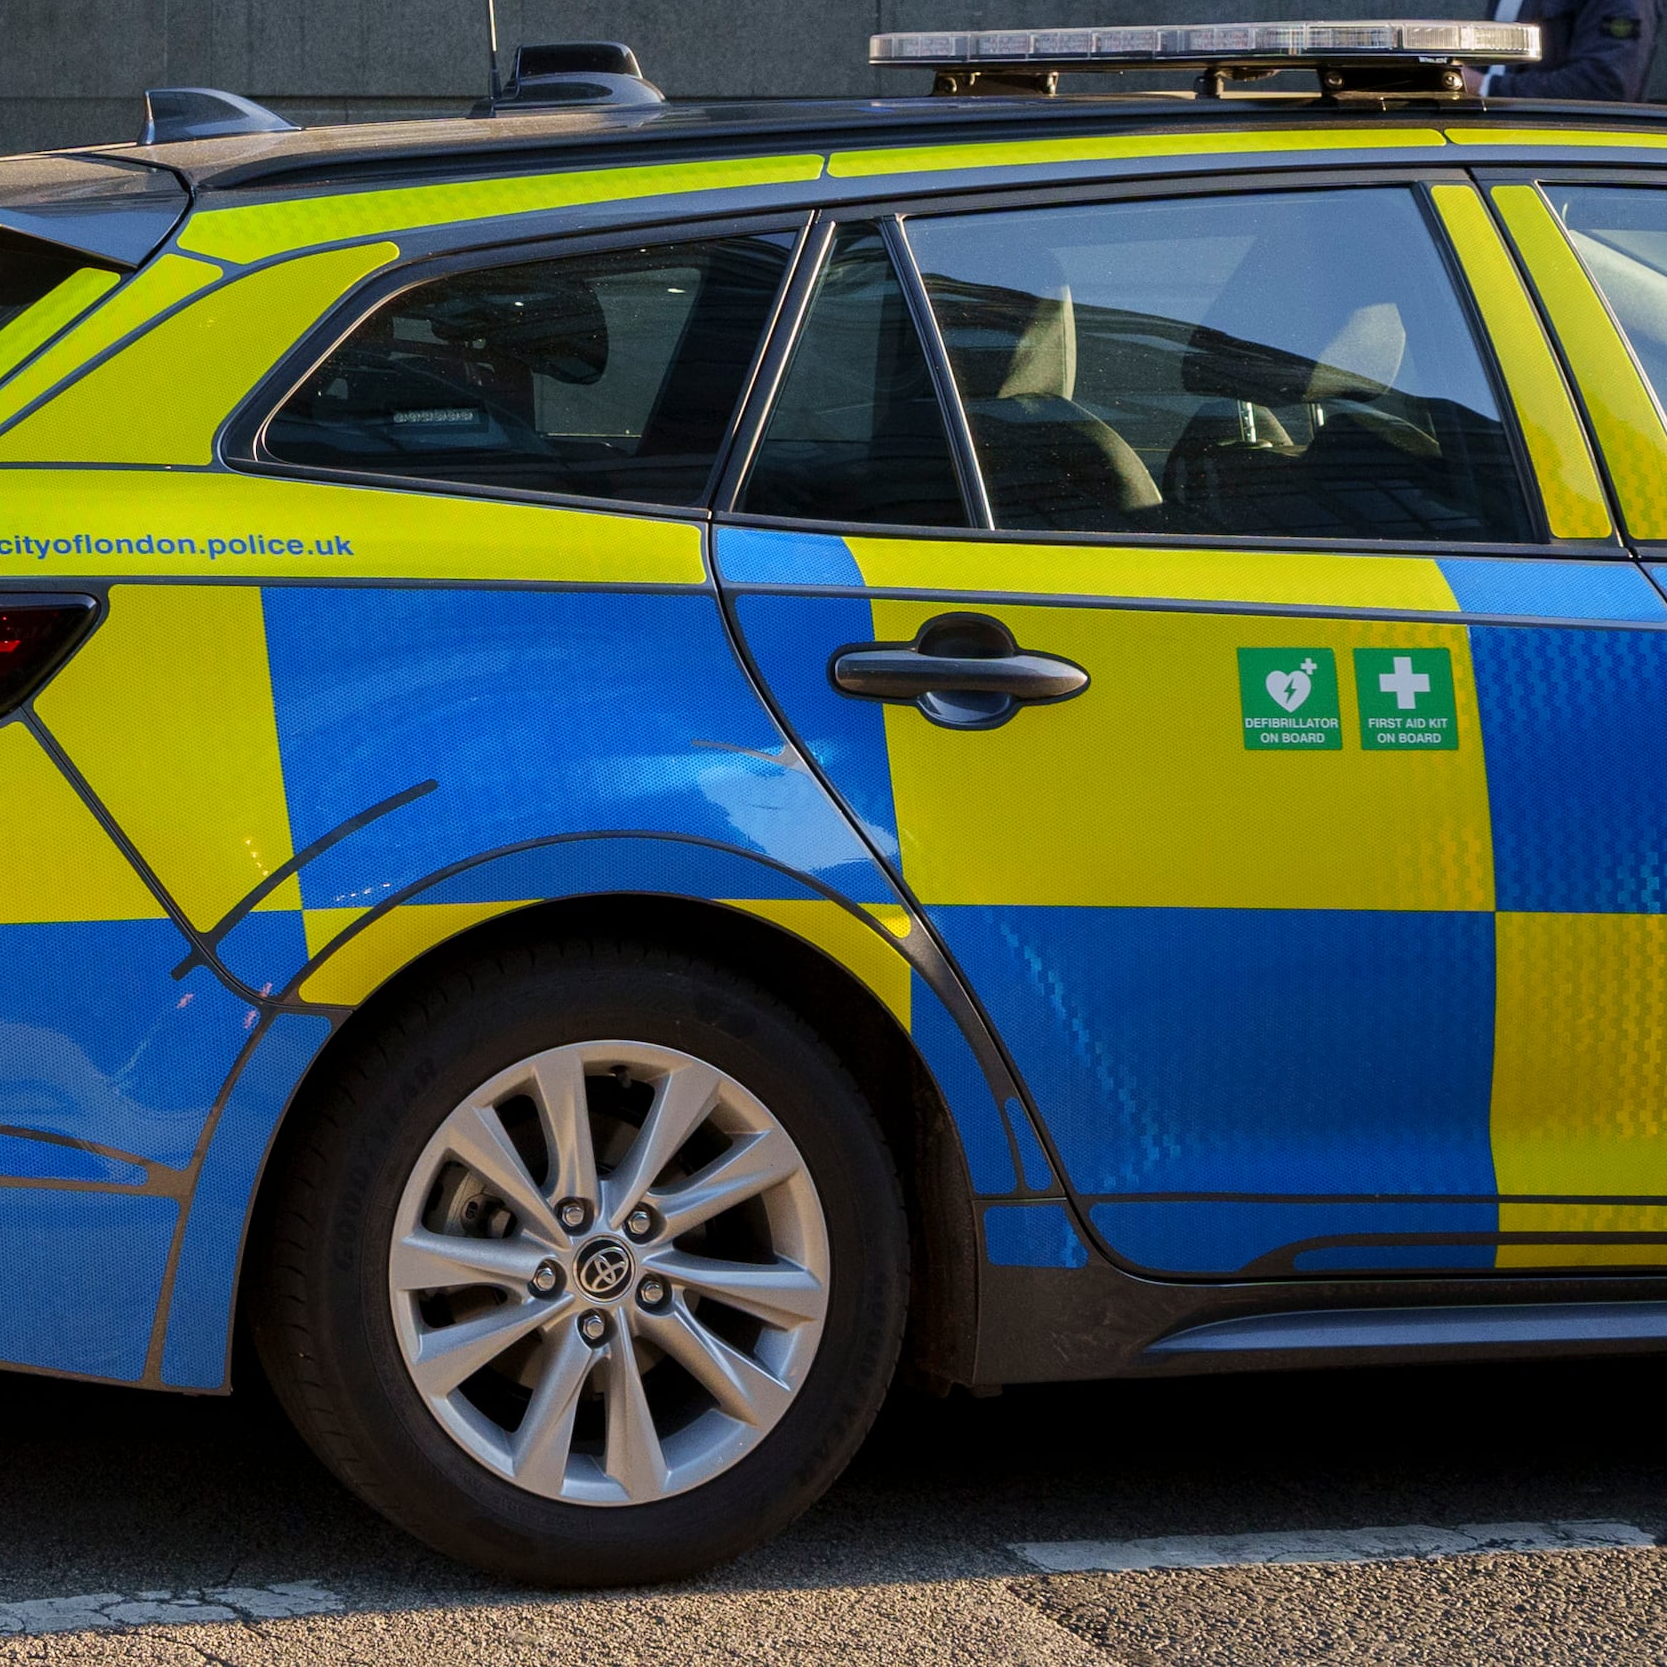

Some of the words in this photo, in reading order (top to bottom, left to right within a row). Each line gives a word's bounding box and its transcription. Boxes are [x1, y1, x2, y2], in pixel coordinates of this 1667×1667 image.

[1244, 717, 1339, 729] DEFIBRILLATOR
[1368, 717, 1403, 729] FIRST
[1405, 717, 1427, 729] AID
[1429, 717, 1448, 729] KIT
[1260, 733, 1279, 744] ON
[1282, 733, 1325, 744] BOARD
[1377, 733, 1396, 744] ON
[1398, 733, 1441, 744] BOARD
